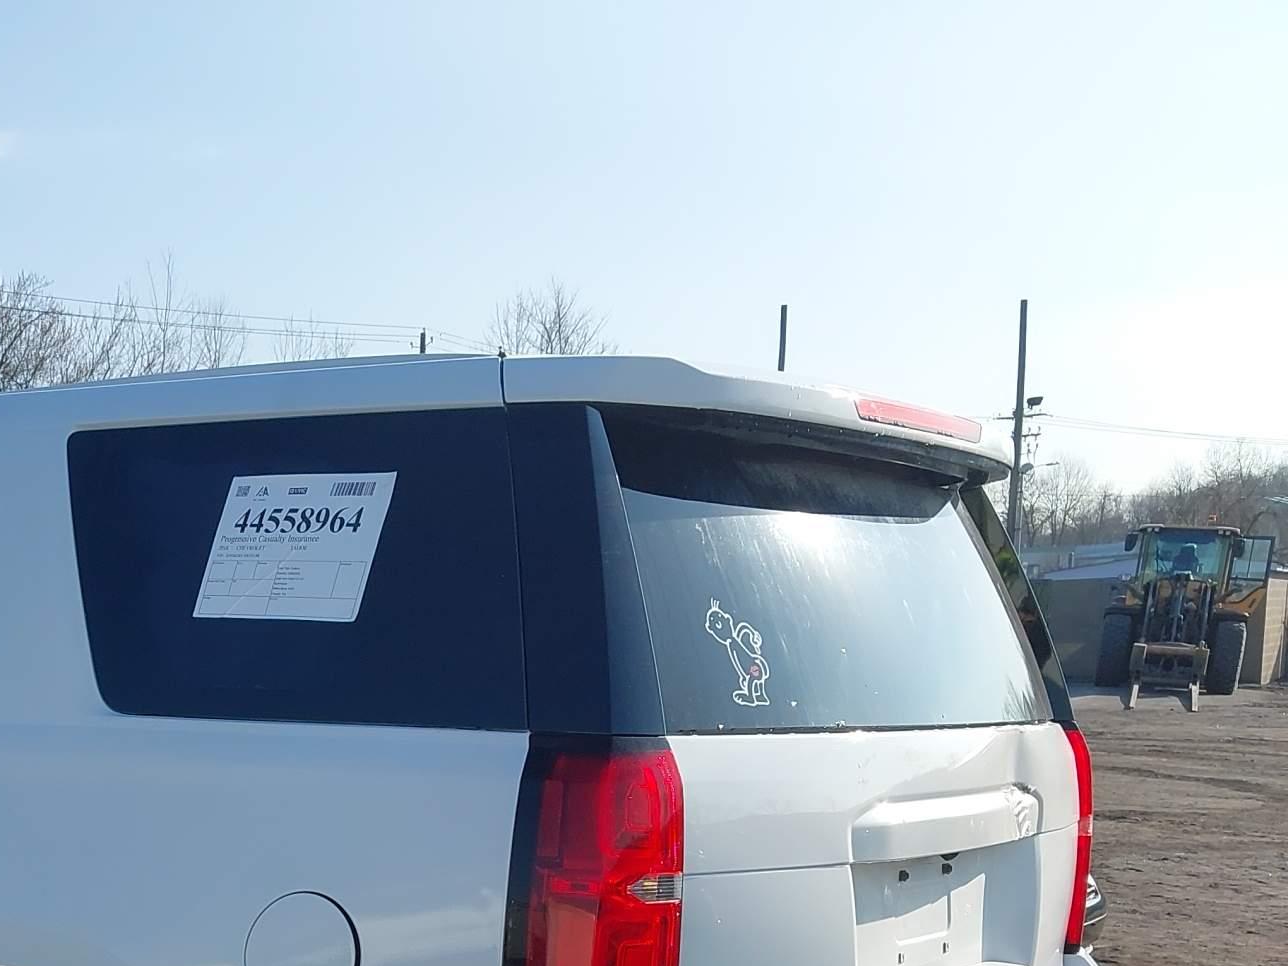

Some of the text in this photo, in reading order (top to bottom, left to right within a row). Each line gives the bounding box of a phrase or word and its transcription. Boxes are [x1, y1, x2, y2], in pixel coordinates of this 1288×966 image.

[234, 506, 364, 534] 44558964
[220, 535, 320, 545] Progressive Casualty Insurance
